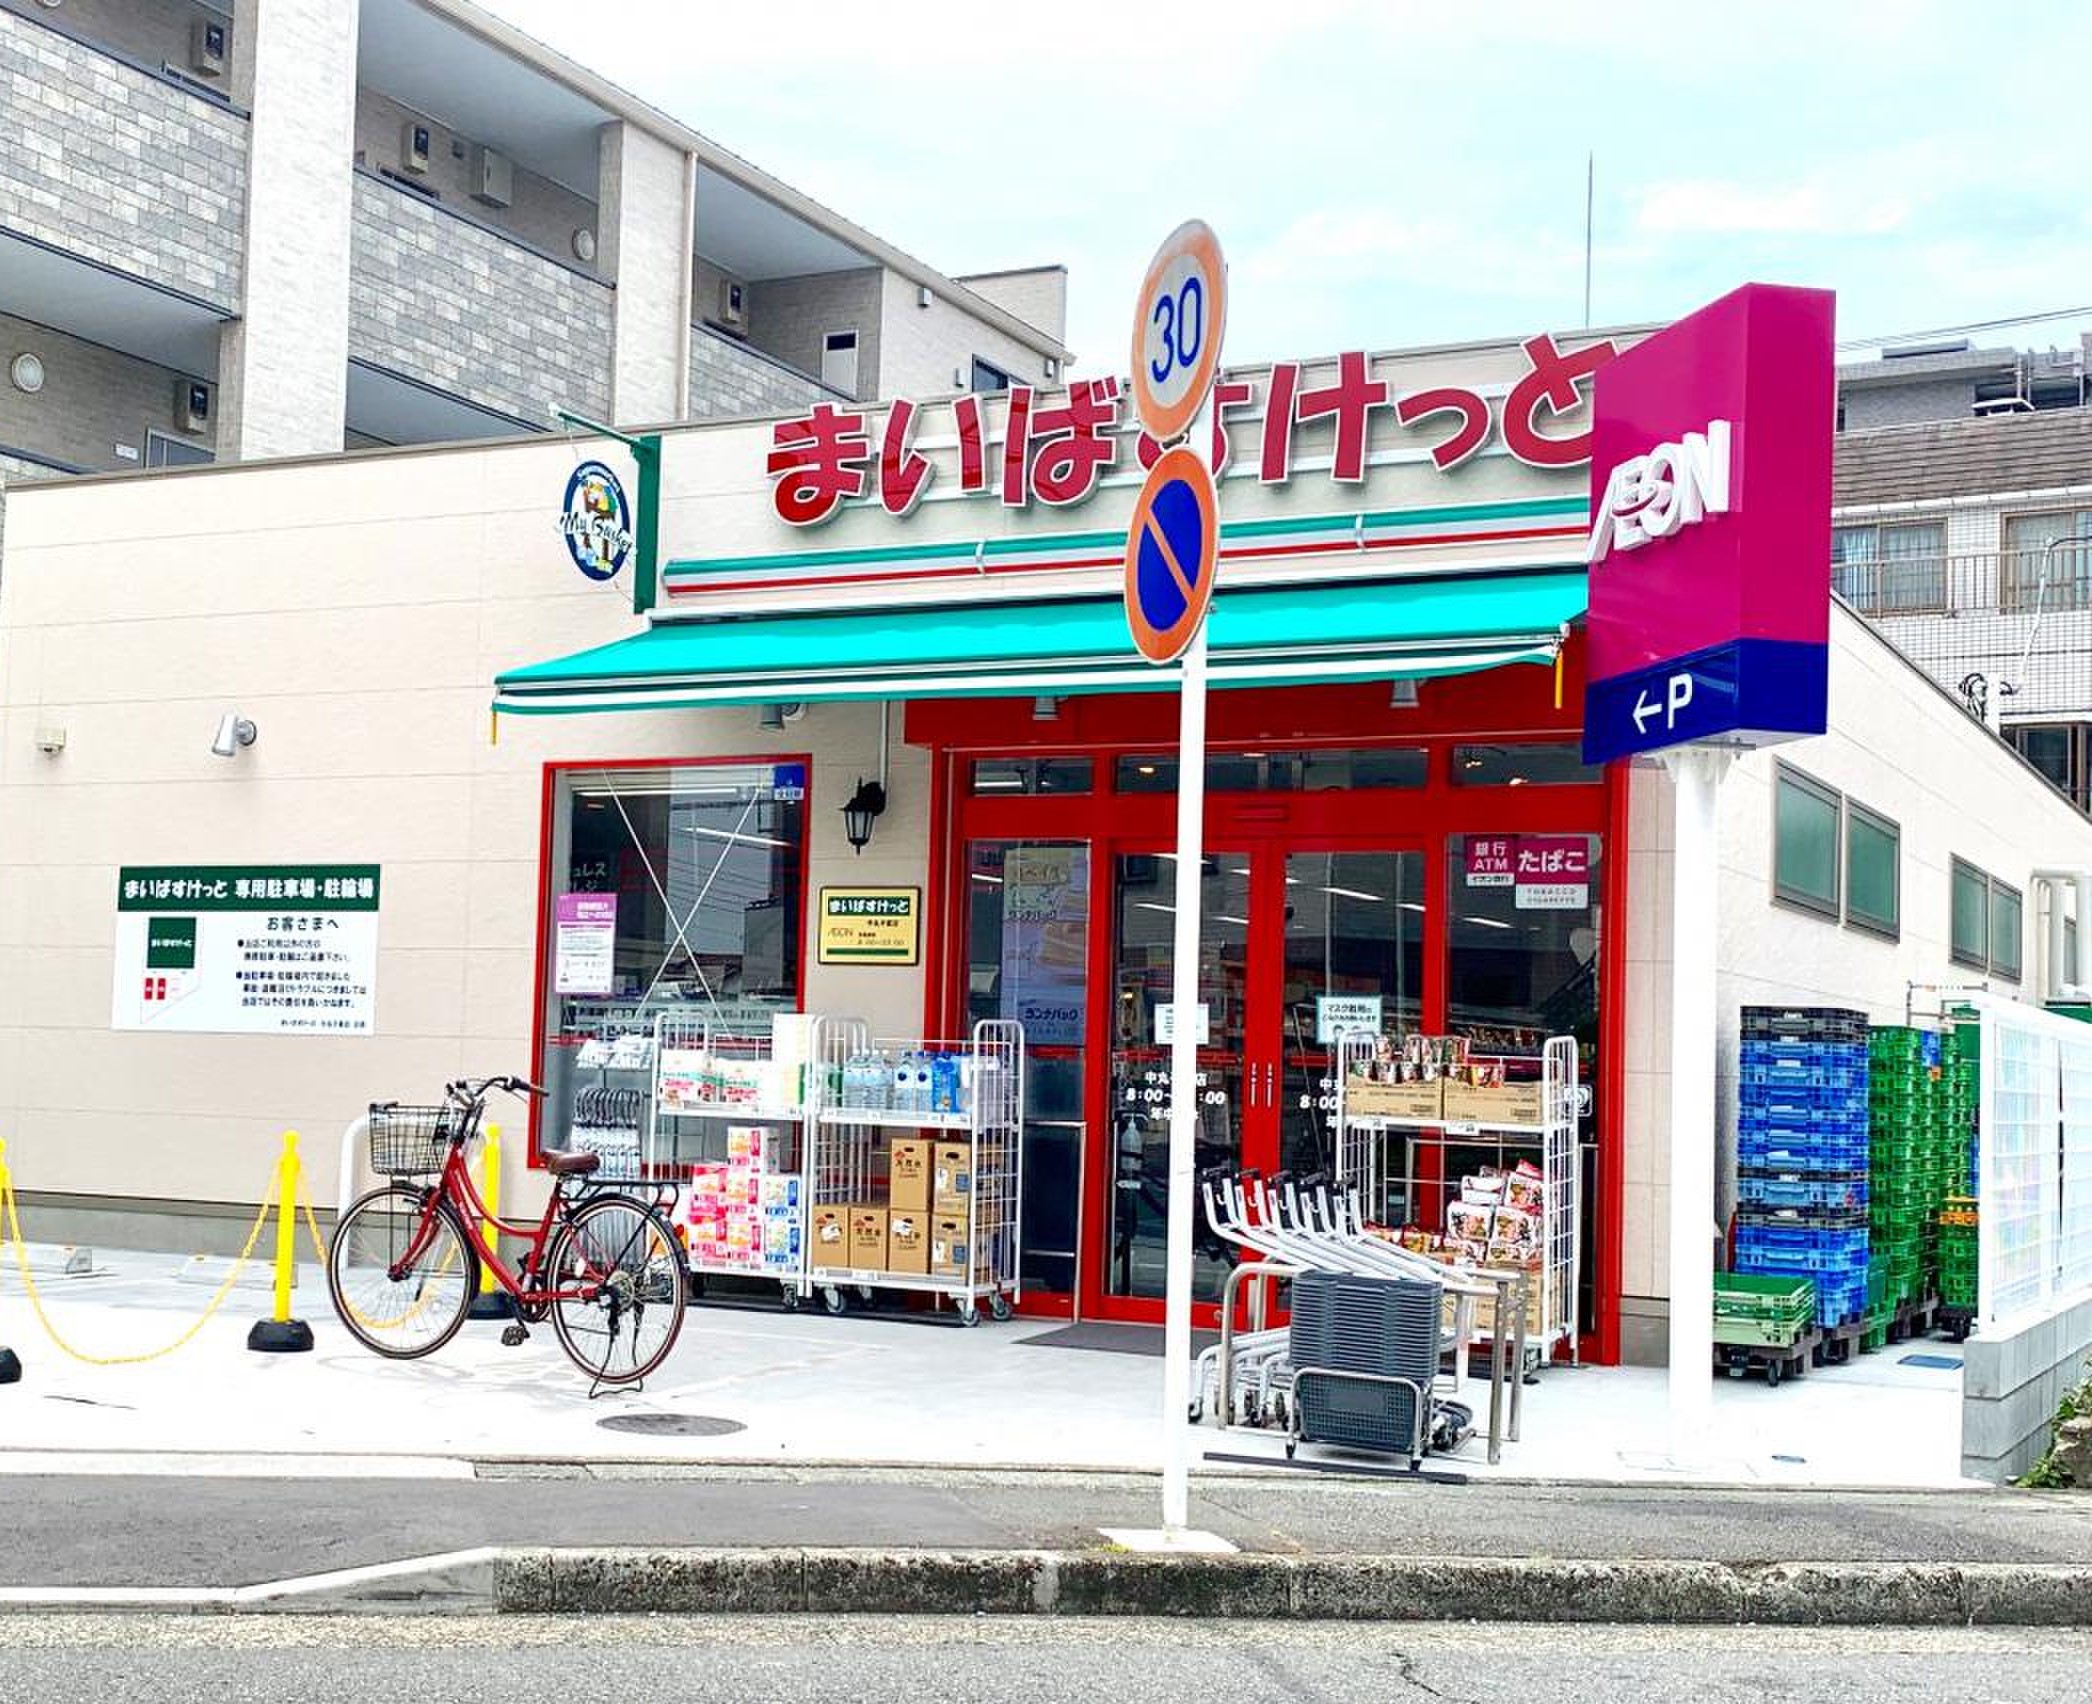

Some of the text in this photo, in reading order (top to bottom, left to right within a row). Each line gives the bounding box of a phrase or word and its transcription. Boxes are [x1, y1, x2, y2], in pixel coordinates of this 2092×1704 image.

[1152, 276, 1202, 384] 30
[1667, 672, 1694, 730] P
[1474, 841, 1508, 857] 銀行
[1473, 858, 1509, 871] ATM
[1518, 848, 1586, 873] たばこ
[123, 877, 374, 899] まいばすけっと 専用駐車場・駐輪場
[829, 899, 909, 913] まいばすけっと
[267, 917, 339, 931] お客さまへ
